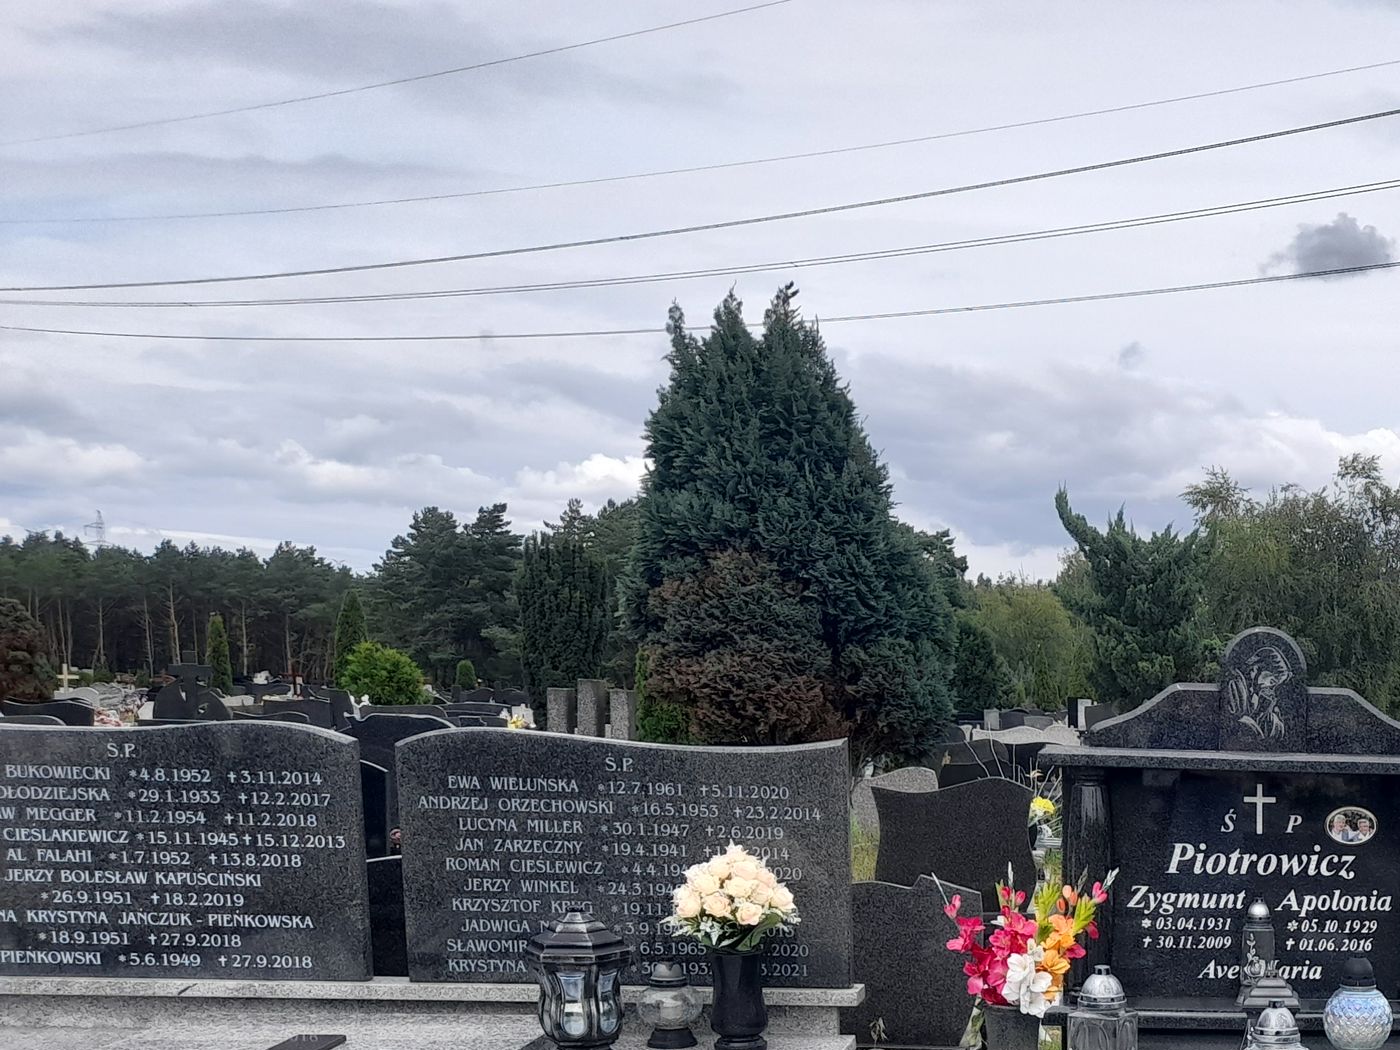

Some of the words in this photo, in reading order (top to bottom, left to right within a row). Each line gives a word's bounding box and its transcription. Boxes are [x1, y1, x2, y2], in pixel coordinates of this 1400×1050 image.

[5, 764, 111, 780] BUKOWIECKI
[139, 768, 212, 783] 4.8.1952
[240, 770, 323, 786] 3.11.2014
[448, 775, 481, 790] EWA
[490, 774, 579, 792] WIELUŃSKA
[608, 781, 683, 796] 12.7.1961
[711, 784, 790, 800] 5.11.2020
[138, 789, 221, 804] 29.1.1933
[251, 792, 331, 807] 12.2.2017
[0, 806, 16, 820] W
[26, 807, 97, 821] MEGGER
[126, 810, 207, 825] 11.2.1954
[237, 813, 318, 828] 11.2.2018
[418, 796, 488, 811] ANDRZEJ
[498, 798, 614, 814] ORZECHOWSKI
[642, 802, 719, 818] 16.5.1953
[745, 806, 822, 821] 23.2.2014
[459, 817, 518, 832] LUCYNA
[527, 819, 583, 834] MILLER
[612, 822, 690, 837] 30.1.1947
[716, 825, 784, 840] 2.6.2019
[1285, 814, 1303, 834] P
[3, 822, 130, 844] CIEŚLAKIEWICZ
[148, 832, 240, 847] 15.11.1945
[255, 834, 346, 849] 15.12.2013
[455, 838, 485, 852] JAN
[494, 839, 583, 854] ZARZECZNY
[612, 842, 688, 857] 19.4.1941
[6, 848, 27, 861] AL
[36, 848, 92, 863] FALAHI
[121, 851, 191, 866] 1.7.1952
[222, 853, 302, 868] 13.8.2018
[445, 857, 501, 872] ROMAN
[510, 856, 604, 875] CIEŚLEWICZ
[1165, 842, 1356, 880] Piotrowicz
[4, 868, 54, 882] JERZY
[60, 869, 148, 885] BOLESŁAW
[155, 867, 262, 887] KAPUŚCIŃSKI
[463, 878, 512, 892] JERZY
[520, 879, 579, 894] WINKEL
[609, 883, 681, 897] 24.3.194
[51, 890, 132, 905] 26.9.1951
[163, 893, 245, 908] 18.2.2019
[452, 898, 542, 913] KRZYSZTOF
[552, 901, 593, 914] KRG
[1126, 885, 1247, 914] Zygmunt
[1274, 888, 1393, 917] Apolonia
[26, 909, 109, 925] KRYSTYNA
[118, 908, 192, 927] JAŃCZUK
[207, 910, 314, 929] PIEŃKOWSKA
[461, 919, 531, 933] JADWIGA
[1155, 917, 1232, 931] 03.04.1931
[1300, 920, 1378, 934] 05.10.1929
[50, 931, 130, 946] 18.9.1951
[160, 933, 242, 948] 27.9.2018
[447, 938, 528, 953] SŁAWOMIR
[1156, 936, 1232, 950] 30.11.2009
[1299, 938, 1374, 952] 01.06.2016
[129, 953, 201, 967] 5.6.1949
[231, 954, 313, 969] 27.9.2018
[448, 959, 528, 973] KRYSTYNA
[1197, 959, 1240, 979] Ave
